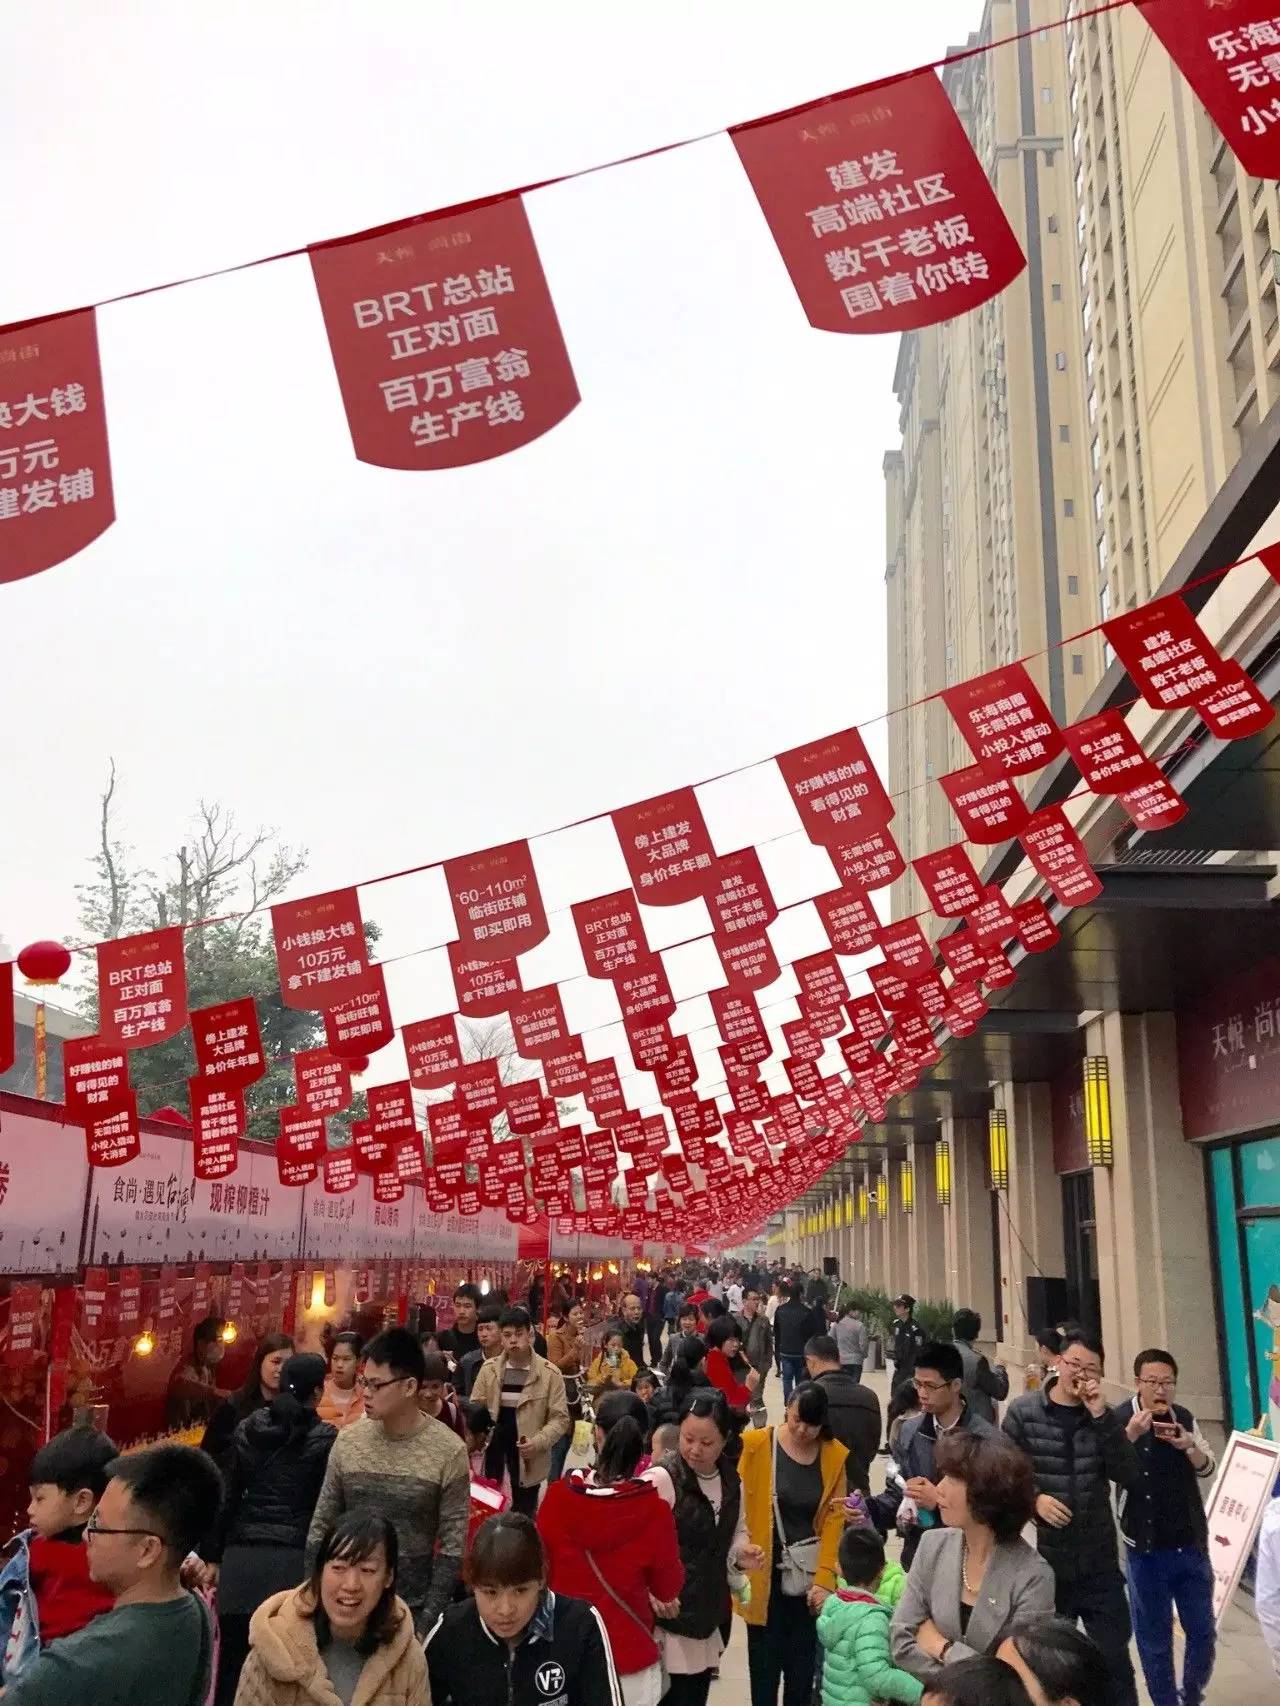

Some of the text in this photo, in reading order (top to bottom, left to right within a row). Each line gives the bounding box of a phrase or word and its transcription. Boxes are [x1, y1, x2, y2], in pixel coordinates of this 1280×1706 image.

[1241, 98, 1280, 135] 小
[826, 149, 904, 192] 建发
[805, 173, 955, 238] 高端社区
[824, 214, 975, 281] 数千老板
[353, 264, 515, 329] BRT总站
[840, 251, 990, 318] 围着你转
[387, 306, 500, 360] 正对面
[379, 347, 531, 412] 百万富翁
[410, 390, 525, 446] 生产线
[1139, 638, 1197, 671] 高端社区
[1143, 630, 1174, 651] 建发
[1159, 670, 1217, 703] 围着你转
[967, 692, 1027, 724] 乐海商圈
[976, 707, 1034, 738] 无需培育
[980, 722, 1051, 758] 小投入撬动
[1002, 742, 1046, 768] 大消费
[794, 760, 868, 796] 好赚钱的铺
[810, 782, 869, 812] 看得见的
[831, 802, 862, 823] 财富
[984, 812, 1008, 827] 财富
[635, 820, 692, 849] 傍上建发
[647, 838, 690, 863] 大品牌
[468, 892, 527, 920] 临街旺铺
[282, 921, 356, 951] 小钱换大钱
[473, 913, 532, 941] 即买即用
[297, 946, 346, 969] 10万元
[109, 960, 173, 986] BRT总站
[288, 959, 362, 990] 拿下建发铺
[120, 979, 163, 1001] 正对面
[113, 998, 172, 1023] 百万富翁
[121, 1017, 166, 1040] 生产线
[213, 1039, 246, 1057] 大品牌
[75, 1074, 119, 1094] 看得见的
[87, 1092, 109, 1105] 财富
